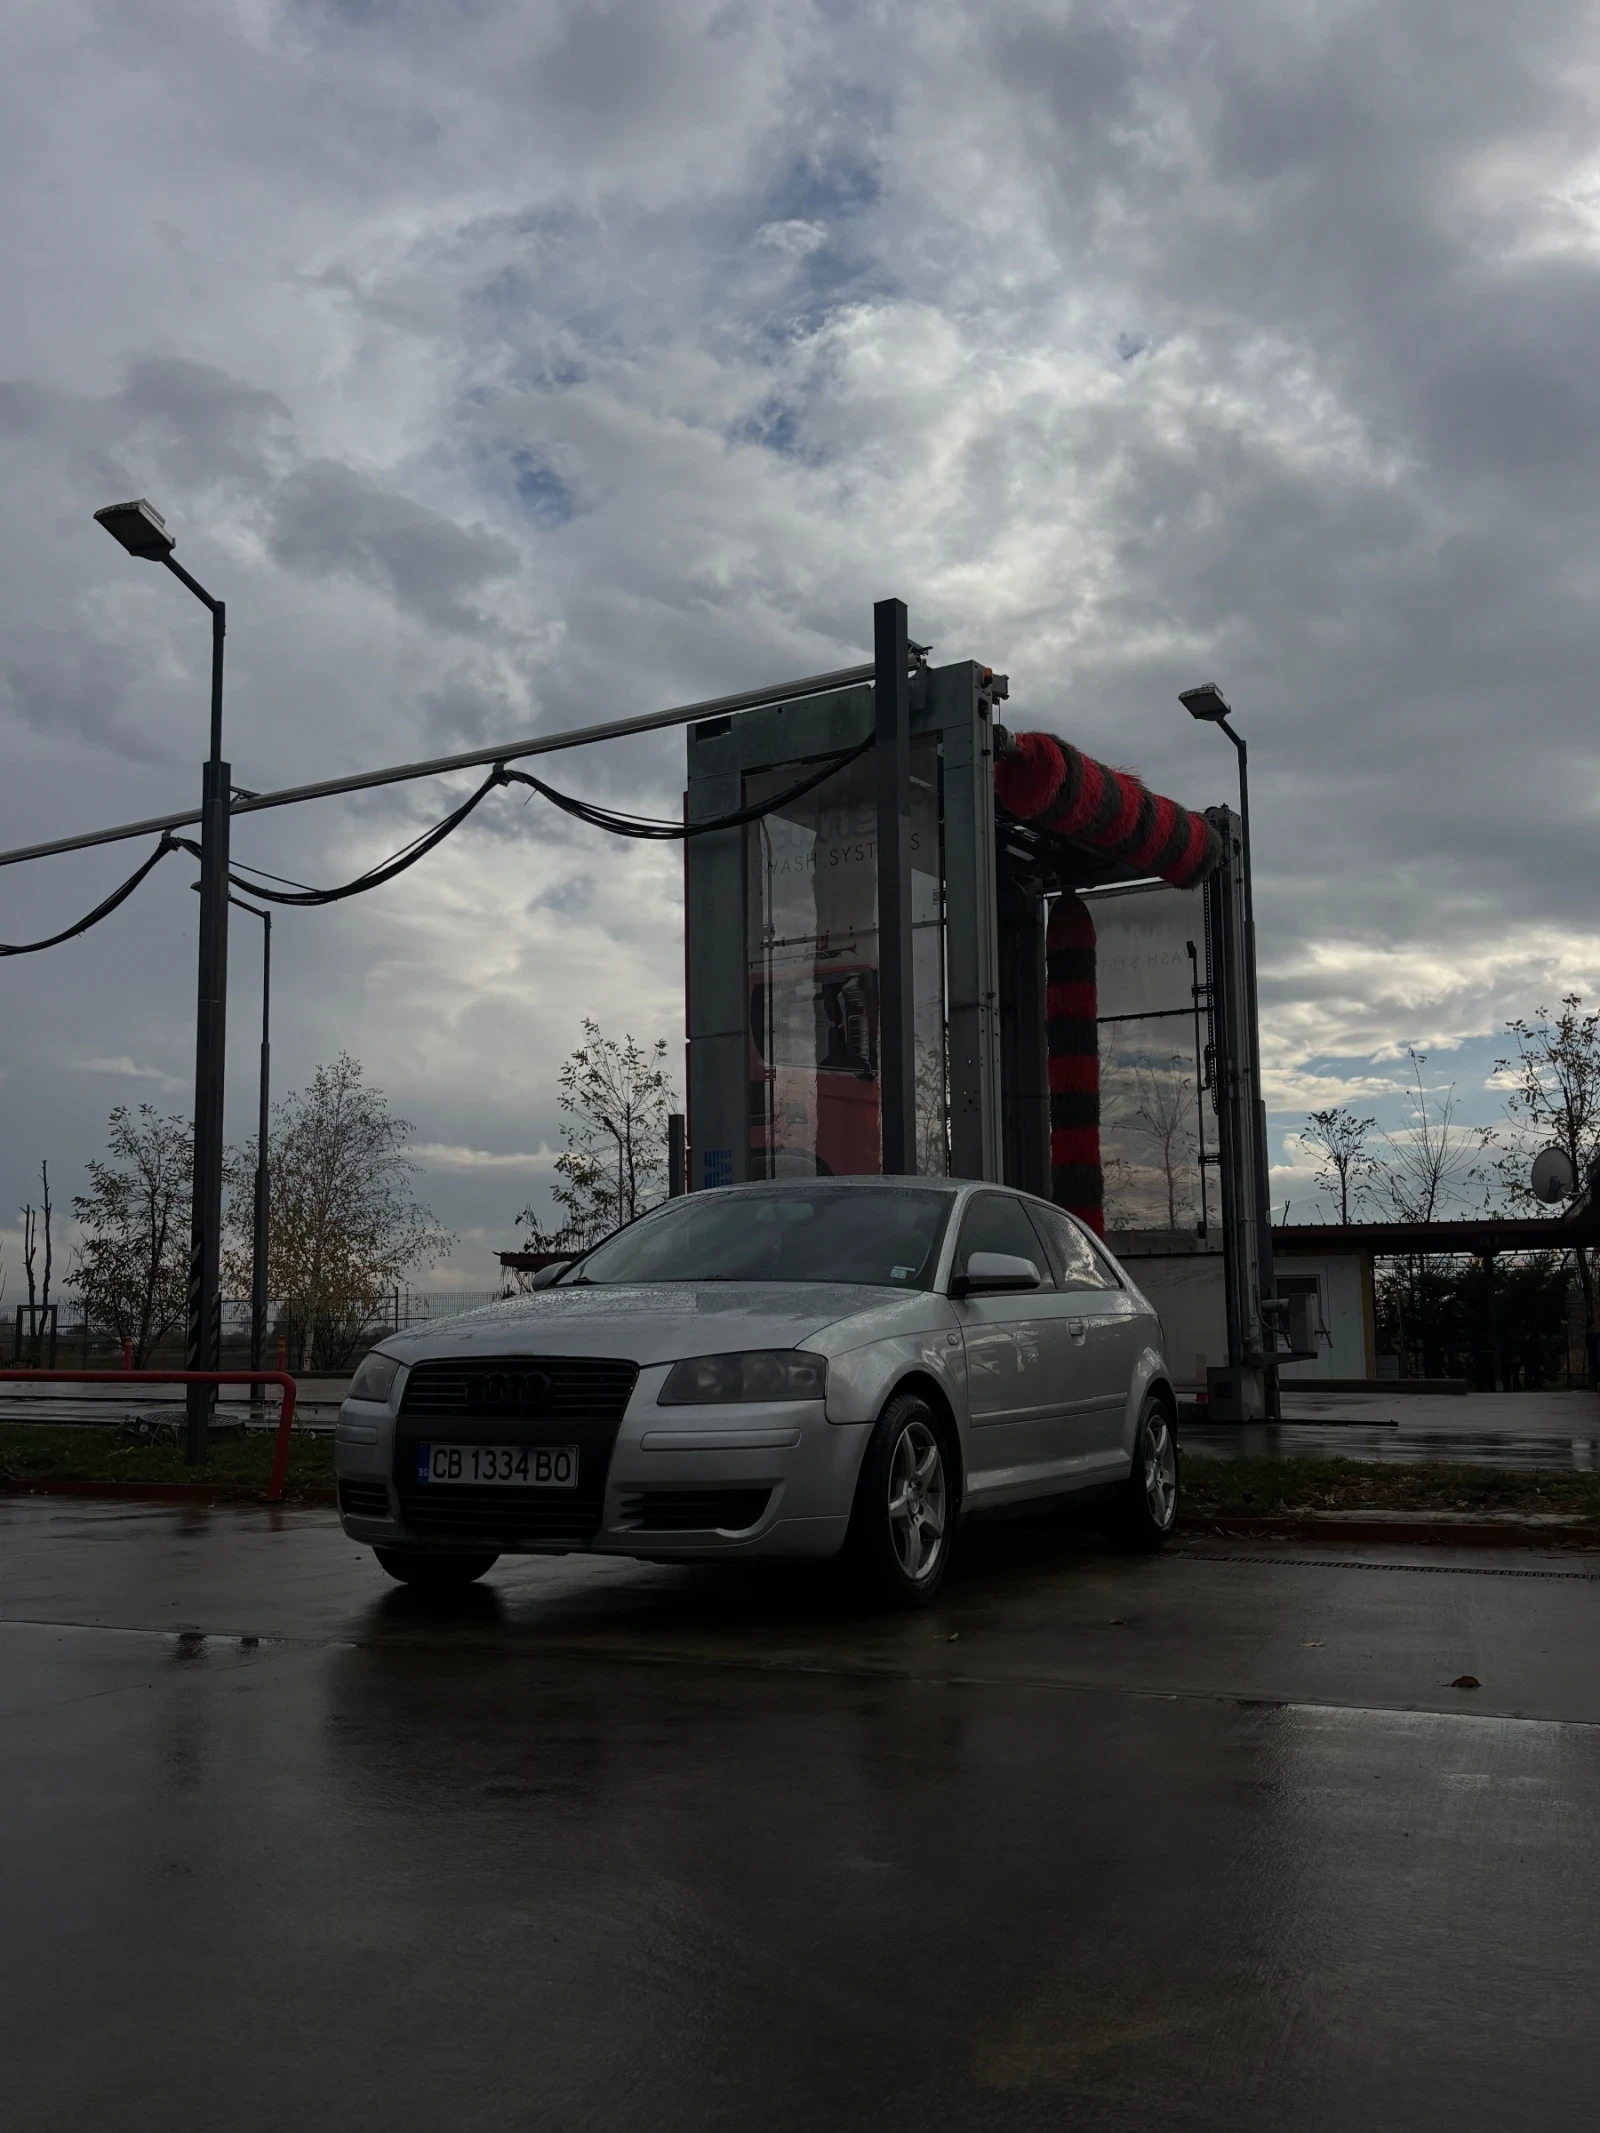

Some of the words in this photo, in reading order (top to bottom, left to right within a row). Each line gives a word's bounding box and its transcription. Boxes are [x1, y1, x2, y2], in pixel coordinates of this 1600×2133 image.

[763, 852, 817, 875] WASH
[829, 833, 920, 866] SYSTS
[418, 1467, 429, 1477] BG
[433, 1449, 462, 1479] CB
[471, 1450, 530, 1481] 1334
